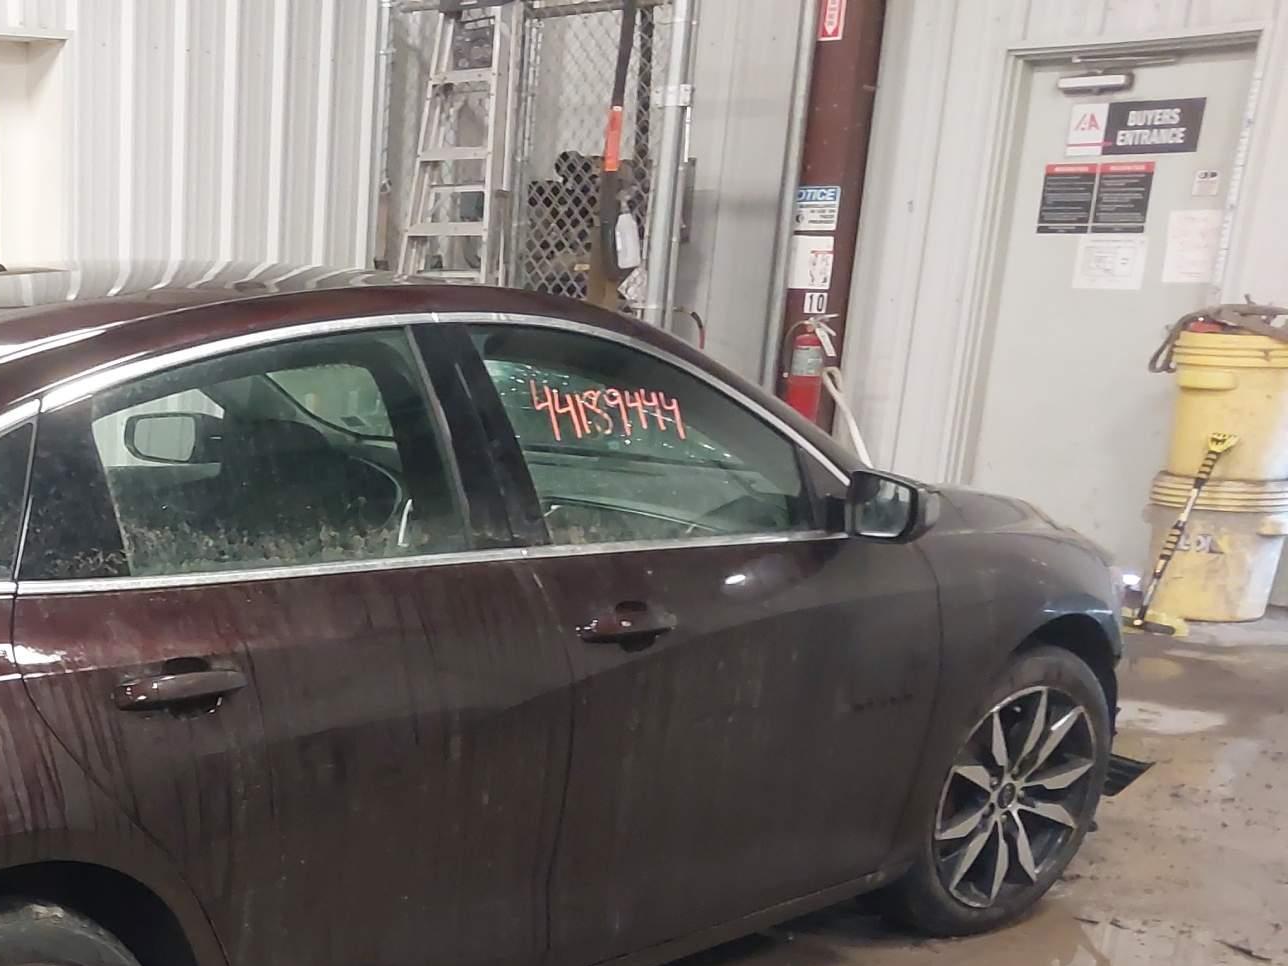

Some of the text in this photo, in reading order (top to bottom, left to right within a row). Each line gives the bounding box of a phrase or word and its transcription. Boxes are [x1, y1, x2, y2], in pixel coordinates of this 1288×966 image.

[1127, 108, 1182, 126] BUYERS
[1116, 128, 1187, 146] ENTRANCE
[808, 294, 825, 312] 10
[529, 379, 686, 441] 44189444
